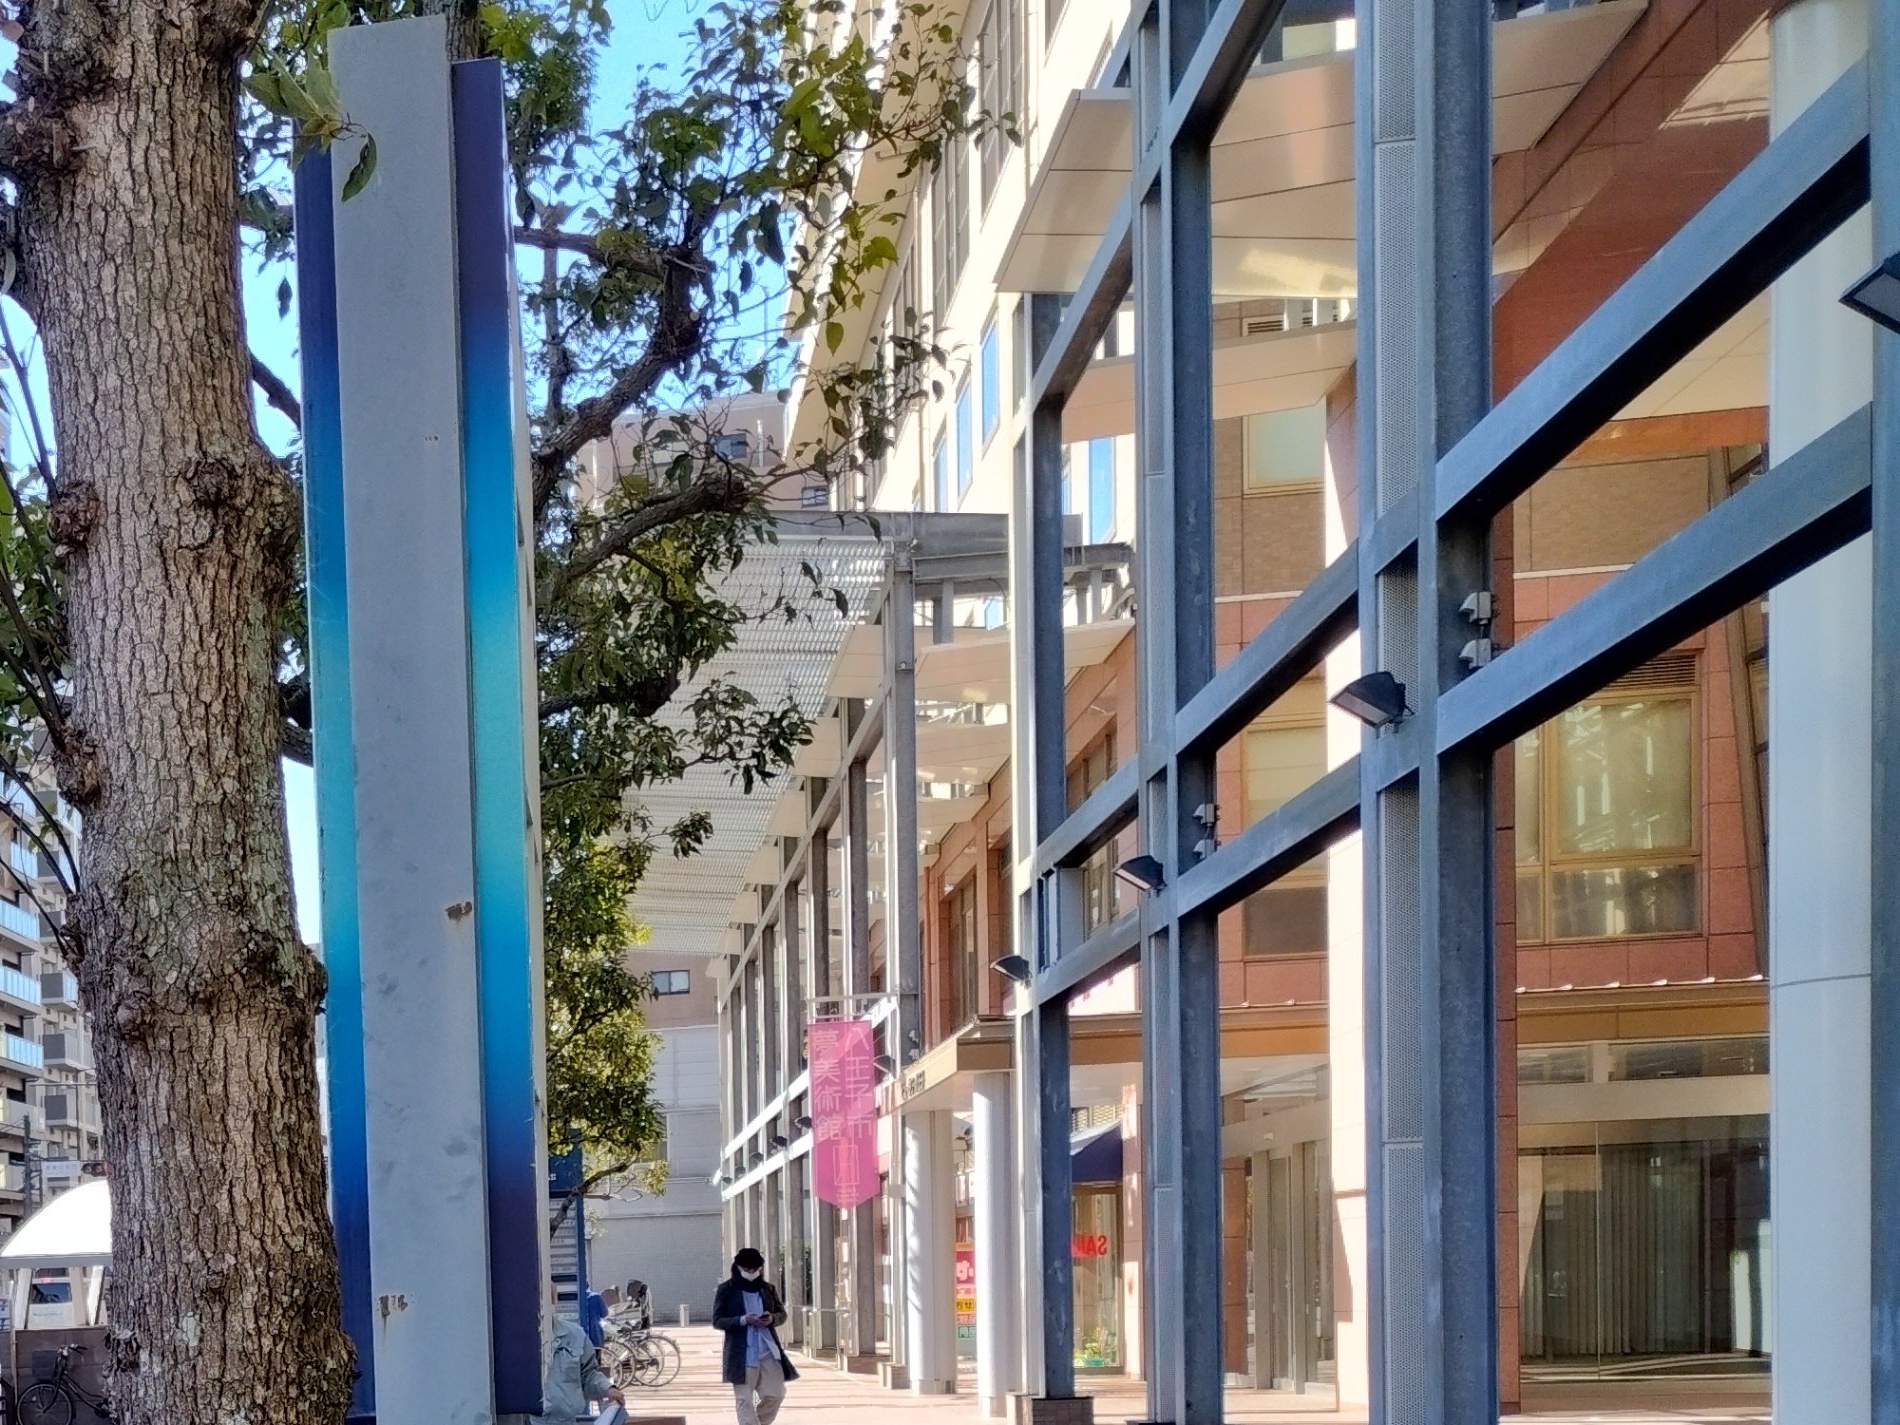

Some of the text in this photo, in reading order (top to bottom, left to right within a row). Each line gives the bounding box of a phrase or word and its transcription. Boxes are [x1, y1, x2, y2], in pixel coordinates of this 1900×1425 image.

[811, 1030, 844, 1141] 夢美術館
[844, 1027, 874, 1140] 八王子市
